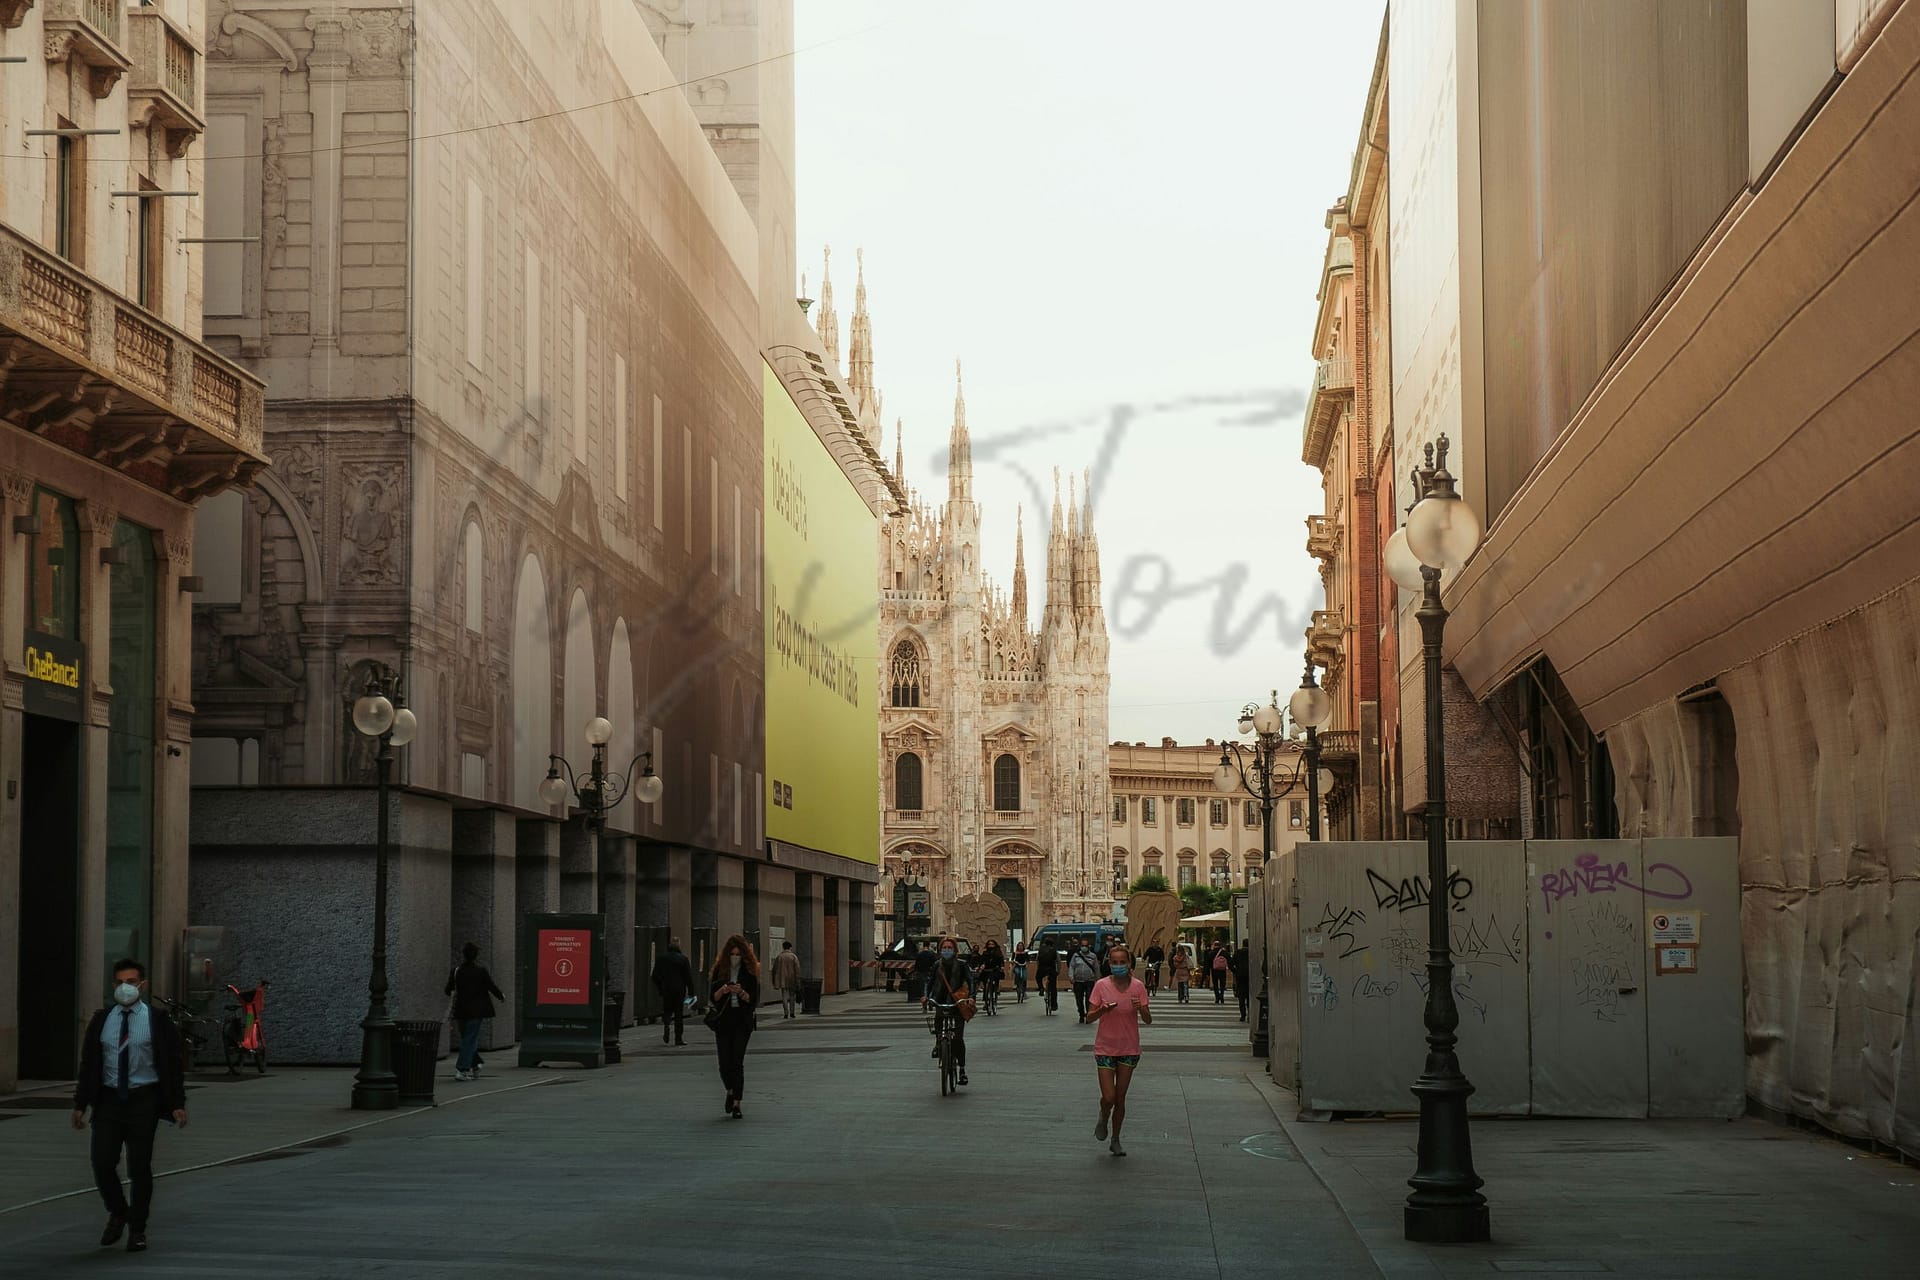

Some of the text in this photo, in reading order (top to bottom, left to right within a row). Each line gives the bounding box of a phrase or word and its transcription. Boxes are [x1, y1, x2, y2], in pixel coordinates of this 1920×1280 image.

[25, 646, 79, 689] CheBanca!
[794, 620, 807, 671] con
[821, 642, 836, 693] case
